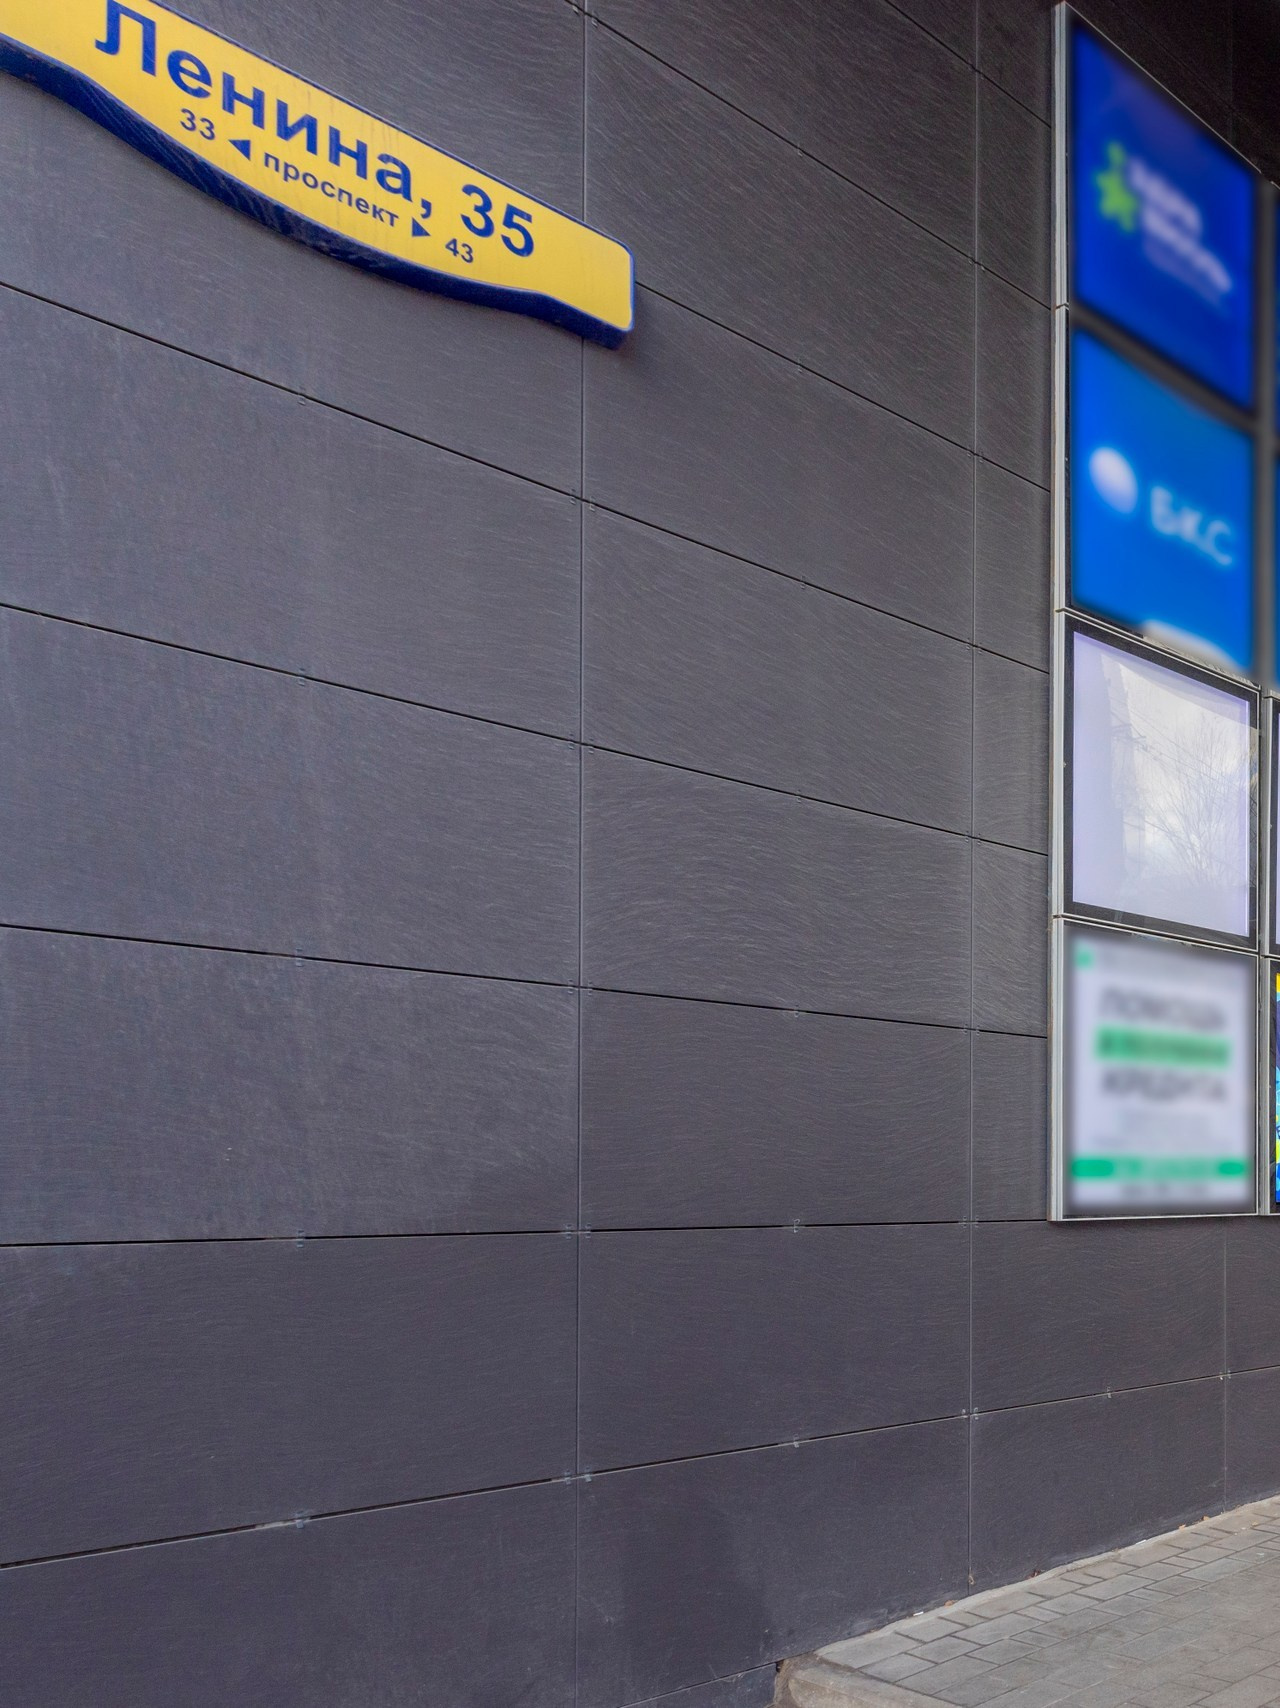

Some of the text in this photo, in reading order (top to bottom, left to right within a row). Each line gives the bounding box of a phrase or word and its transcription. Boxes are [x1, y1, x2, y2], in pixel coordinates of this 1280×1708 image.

[95, 1, 535, 257] Ленина, 35
[180, 108, 474, 264] 33 проспект 43
